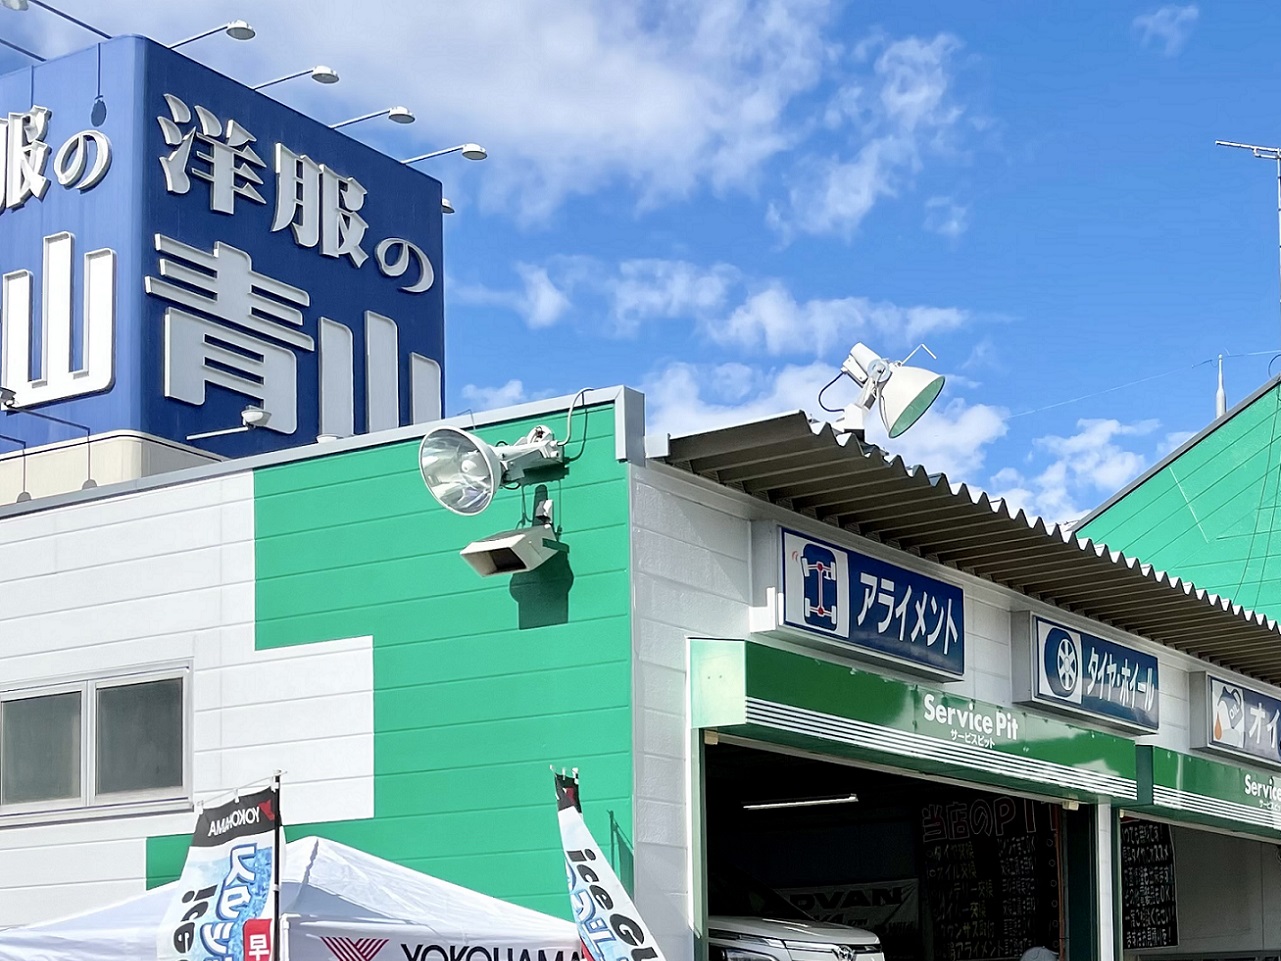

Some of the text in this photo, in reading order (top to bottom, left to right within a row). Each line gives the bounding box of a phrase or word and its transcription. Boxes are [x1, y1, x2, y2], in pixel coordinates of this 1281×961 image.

[157, 93, 435, 294] 洋服の
[144, 233, 442, 440] 青山
[857, 572, 960, 656] アライメント
[1086, 646, 1156, 711] タイヤ・ホイール
[923, 694, 1019, 740] Service Pit
[950, 730, 996, 748] サービスピット
[788, 887, 902, 910] DVAN
